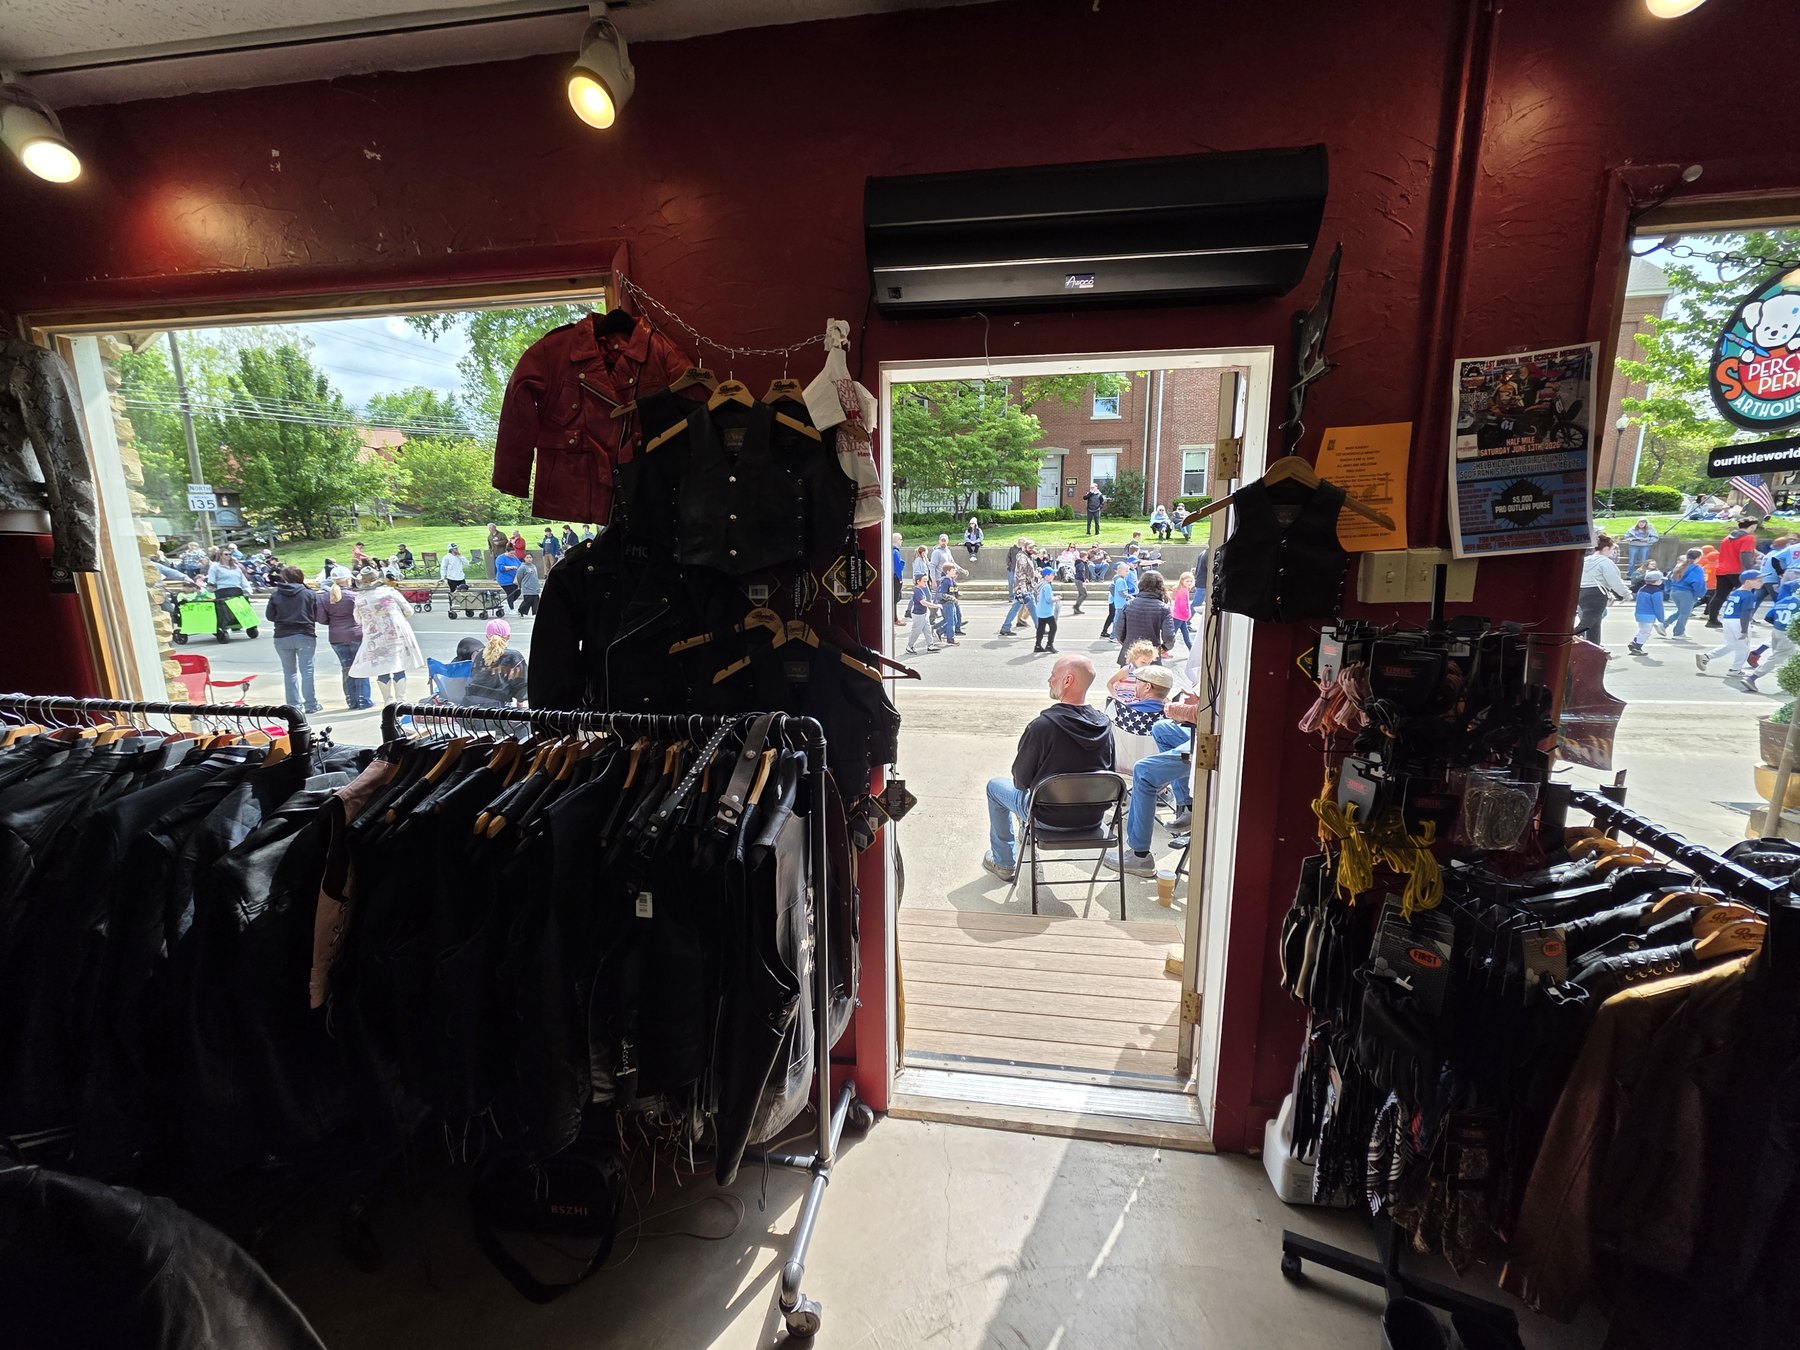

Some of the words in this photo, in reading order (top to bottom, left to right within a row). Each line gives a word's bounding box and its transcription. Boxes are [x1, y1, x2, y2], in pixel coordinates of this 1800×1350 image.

[1748, 353, 1800, 380] PERC
[1506, 437, 1520, 445] HALF
[1521, 436, 1535, 444] MILE
[1480, 447, 1511, 457] SATURDAY
[1512, 446, 1526, 454] JUNE
[1472, 460, 1496, 471] SHELBY
[191, 500, 216, 510] 135
[1494, 503, 1507, 514] PRO
[1507, 502, 1532, 512] OUTLAW
[1532, 500, 1551, 510] PURSE
[1413, 950, 1437, 965] FIRST
